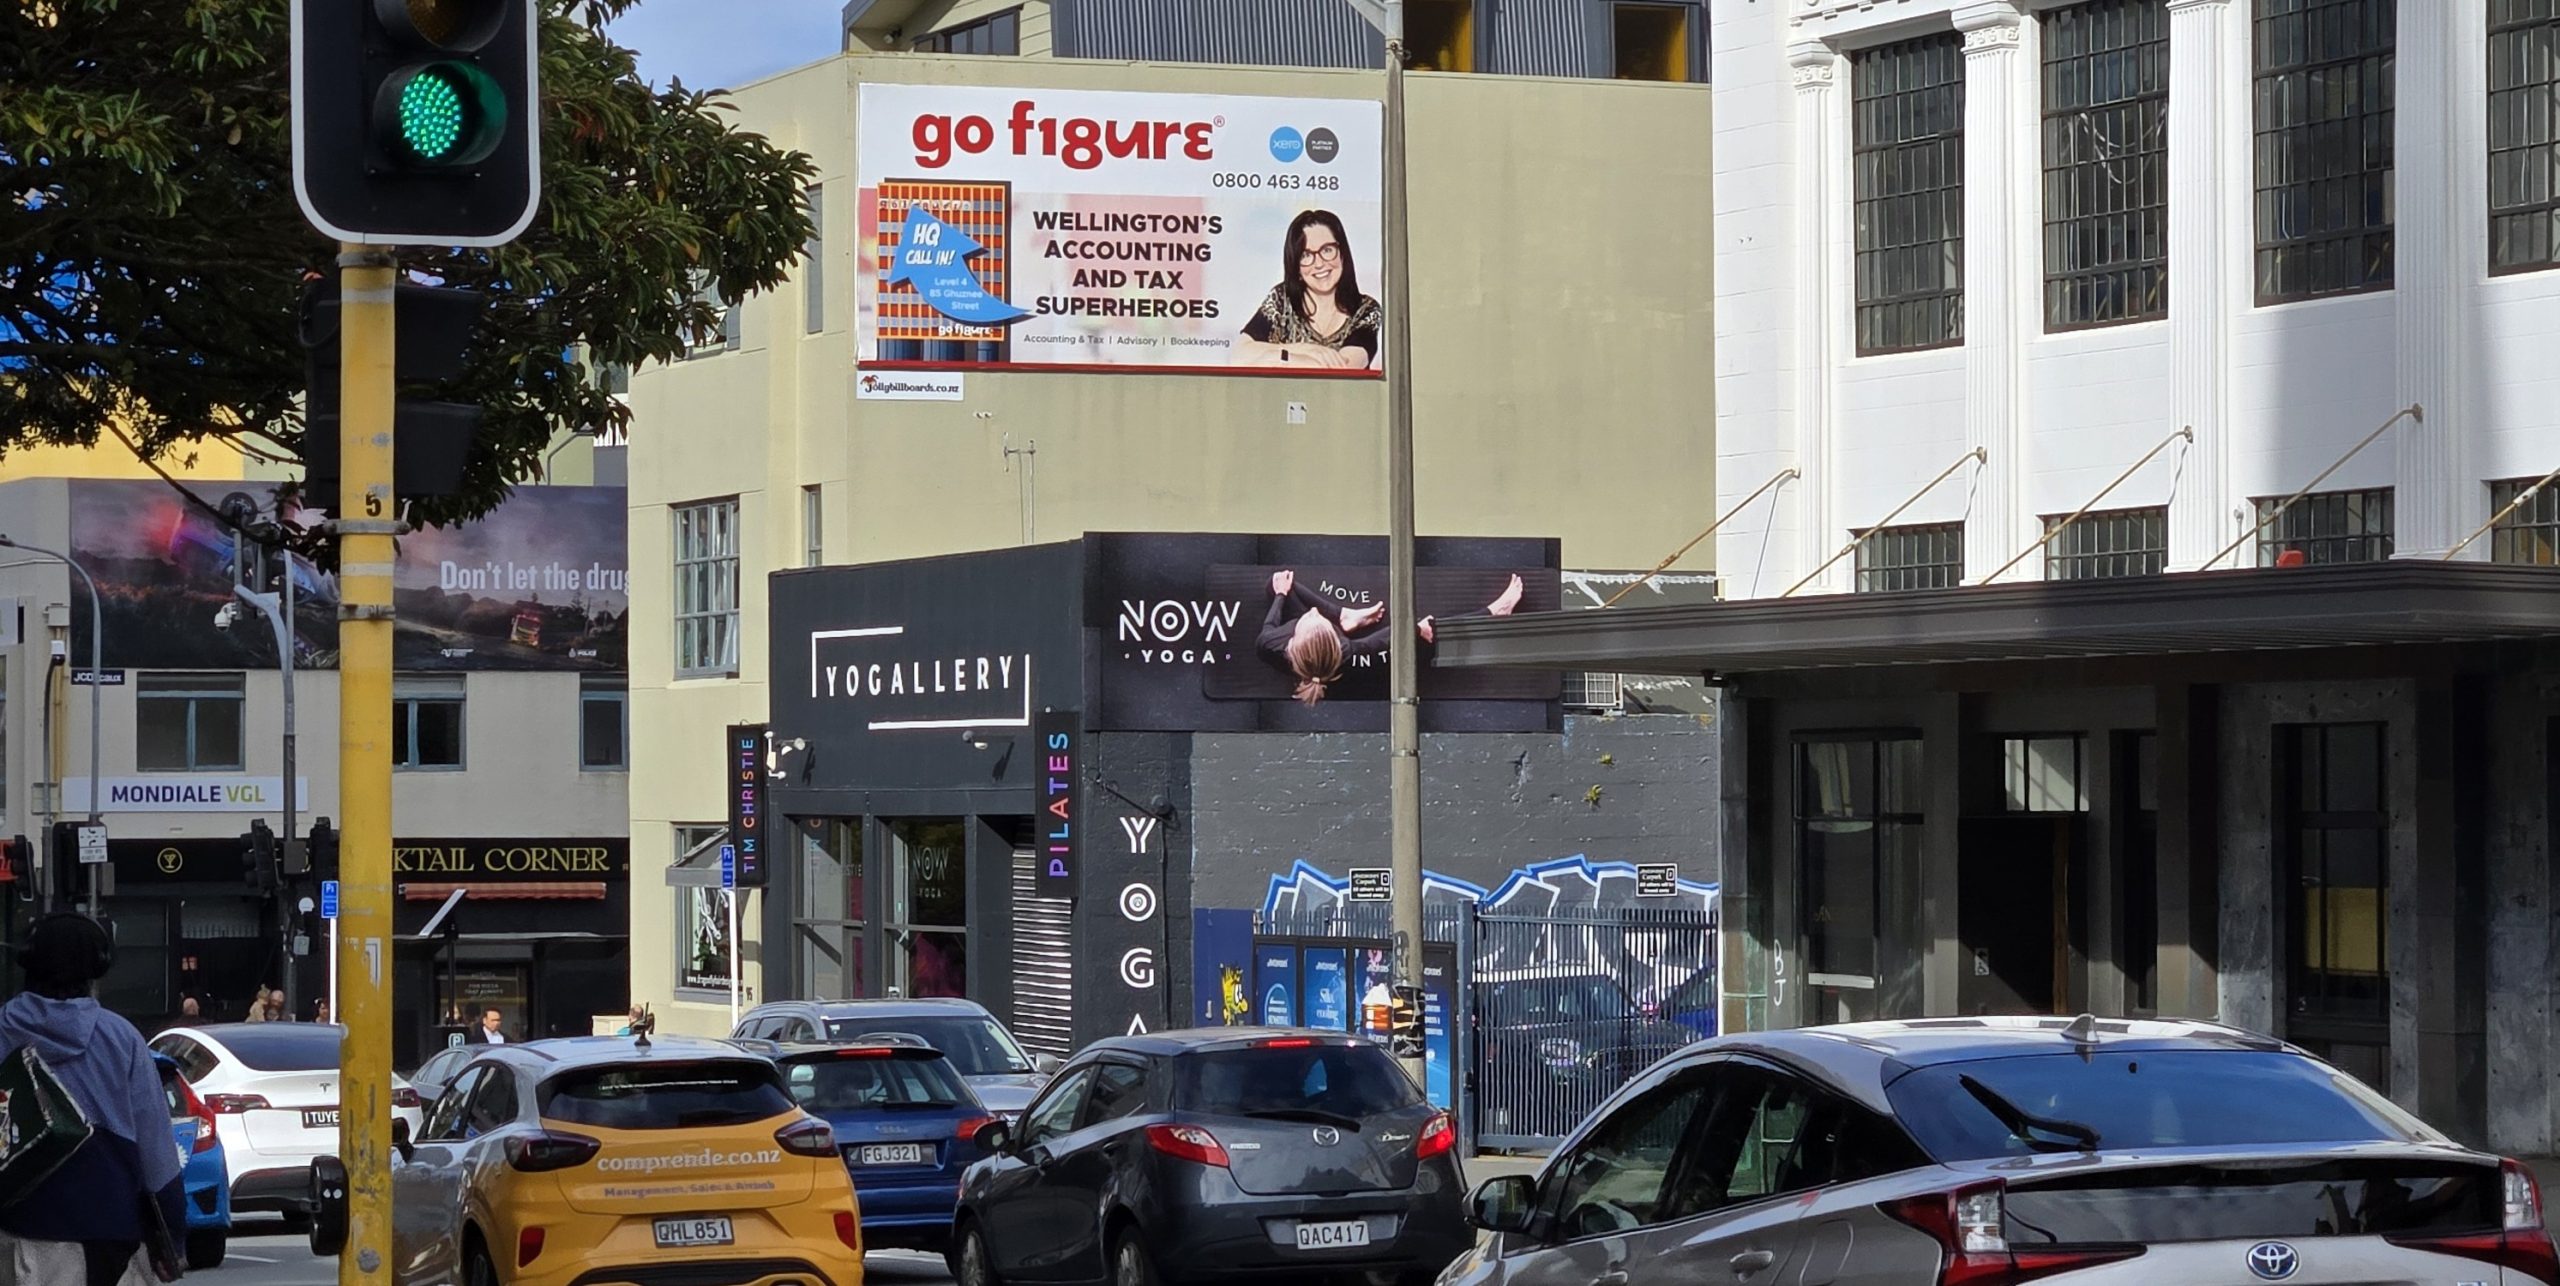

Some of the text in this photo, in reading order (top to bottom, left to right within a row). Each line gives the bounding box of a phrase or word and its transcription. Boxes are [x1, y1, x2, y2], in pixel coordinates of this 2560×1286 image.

[912, 113, 994, 169] go
[1272, 139, 1302, 150] xero
[1212, 173, 1340, 190] 0800 463 488
[1033, 211, 1223, 234] WELLINGTON’S
[912, 222, 941, 248] HQ
[905, 250, 956, 265] CALL IN!
[1044, 239, 1211, 262] ACCOUNTING
[934, 277, 968, 286] Level 4
[1072, 268, 1184, 289] AND TAX
[943, 289, 983, 298] Ghuznee
[951, 301, 980, 310] Street
[1035, 296, 1220, 318] SUPERHEROES
[938, 326, 953, 336] go
[1023, 334, 1230, 348] Accounting & Tax Advisory Bookkeeping
[365, 491, 382, 517] 5
[440, 560, 502, 590] Don’t
[507, 561, 538, 590] let
[543, 561, 580, 590] the
[1319, 580, 1370, 604] MOVE
[1119, 600, 1241, 642] NOW
[1141, 649, 1216, 664] YOGA
[73, 672, 121, 682] JCDcaux
[825, 655, 1012, 697] YOGALLERY
[111, 785, 266, 803] MONDIALE VGL
[1049, 732, 1069, 877] PILATES
[742, 739, 755, 874] TIM CHRISTIE
[393, 847, 610, 872] KTAIL CORNER
[597, 1148, 781, 1173] comprende.co.nz
[863, 1146, 917, 1161] FGJ321
[658, 1221, 728, 1241] QHL851
[1299, 1224, 1365, 1246] QAC417
